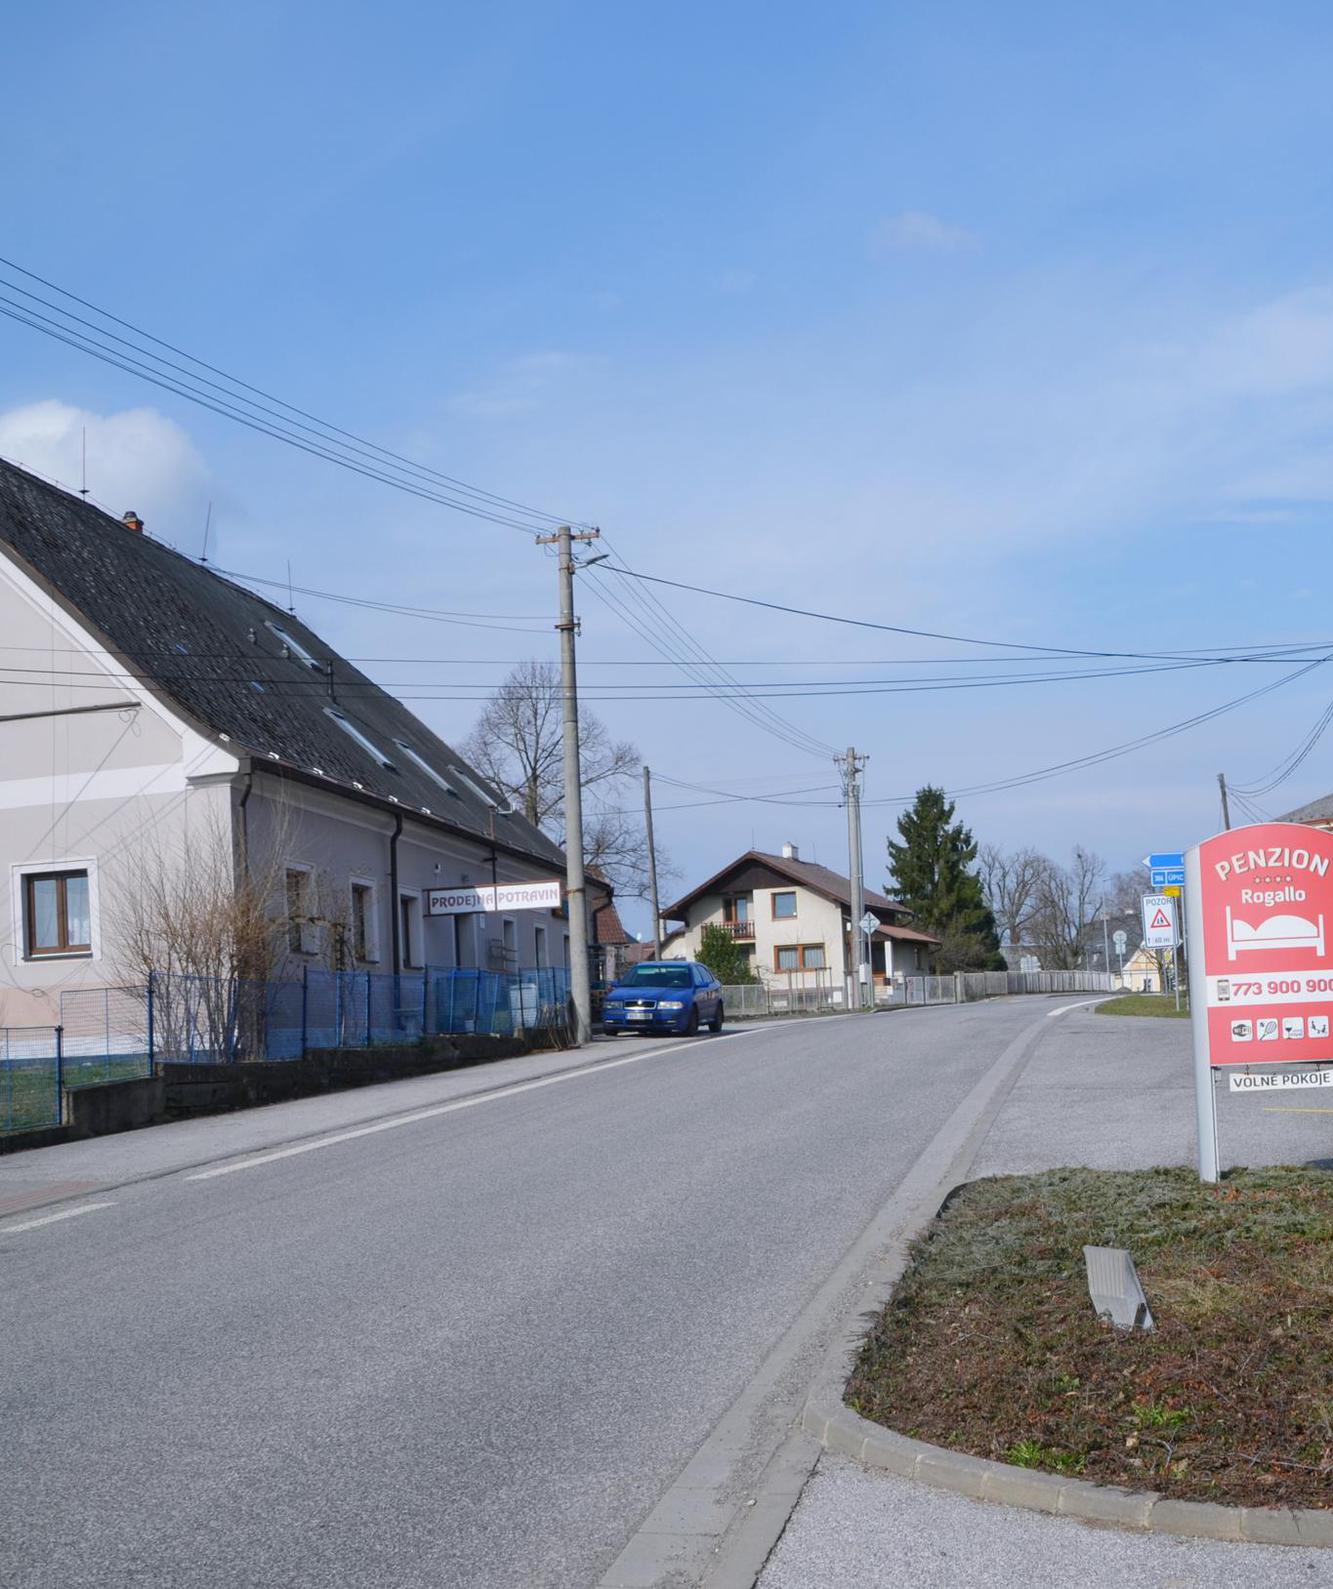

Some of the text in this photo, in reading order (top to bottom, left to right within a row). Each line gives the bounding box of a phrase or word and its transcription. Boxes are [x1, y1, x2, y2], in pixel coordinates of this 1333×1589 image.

[1215, 848, 1330, 881] PENZION
[432, 889, 558, 908] PRODEJNA POTRAVIN
[1241, 886, 1306, 907] Rogallo
[1232, 982, 1263, 996] 773
[1267, 980, 1301, 994] 900
[1233, 1072, 1331, 1088] VOLNÉ POKOJE
